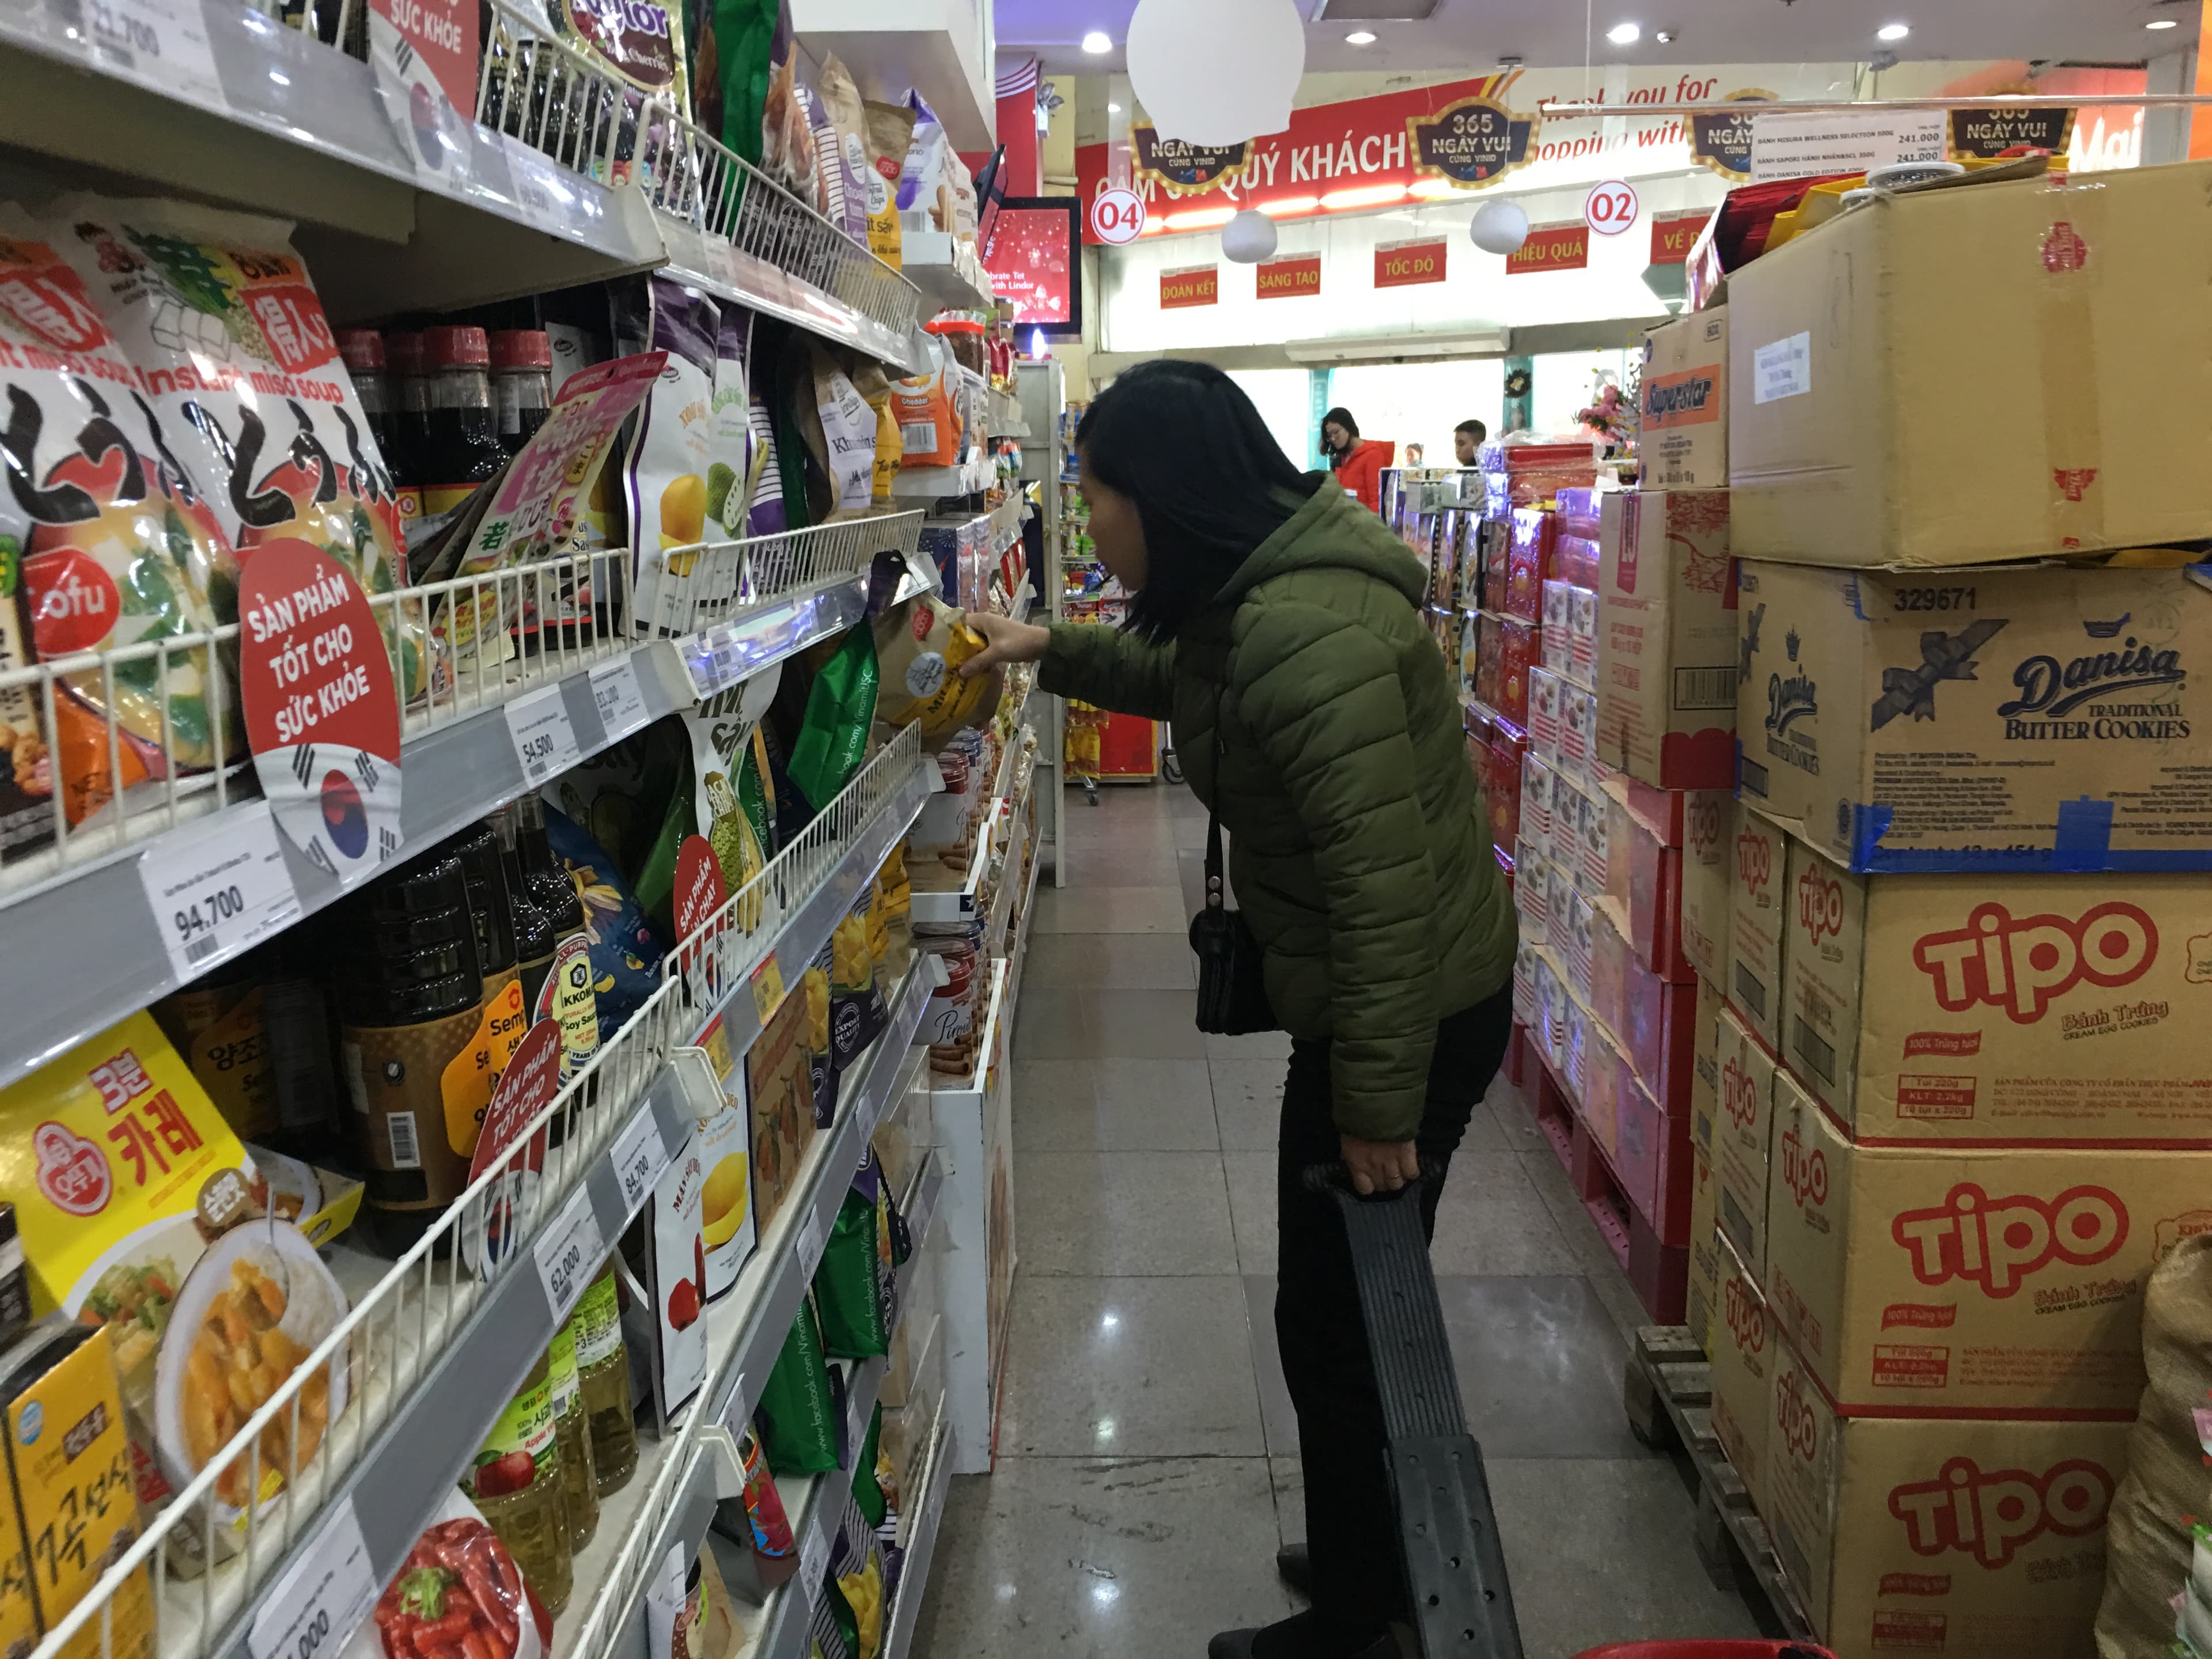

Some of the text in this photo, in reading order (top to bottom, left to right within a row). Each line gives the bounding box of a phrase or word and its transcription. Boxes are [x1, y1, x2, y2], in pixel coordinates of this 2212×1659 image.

[424, 10, 463, 55] KHỎE
[1675, 74, 1718, 103] for
[1452, 113, 1494, 134] 365
[1898, 133, 1940, 144] 241.000
[1967, 116, 2047, 139] NGÀY VUI
[1291, 130, 1405, 182] KHÁCH
[1431, 136, 1512, 154] NGÀY VUI
[1897, 151, 1938, 162] 241.000
[1098, 201, 1139, 231] 04
[1591, 194, 1631, 223] 02
[1384, 252, 1434, 277] TỐC ĐỘ
[1551, 236, 1584, 263] QUẢ
[1009, 281, 1035, 290] Lindor
[1013, 271, 1025, 280] Tet
[1196, 278, 1215, 296] KẾT
[1259, 271, 1292, 289] SÁNG
[296, 378, 344, 404] soup
[901, 396, 929, 406] Cheddar
[27, 575, 105, 620] ofu
[248, 564, 350, 643] SẢN PHẨM
[1893, 587, 1977, 611] 329671
[270, 624, 353, 689] TỐT CHO
[1998, 637, 2187, 718] Danisa
[275, 661, 371, 743] SỨC KHỎE
[2088, 703, 2183, 717] TRADITIONAL
[2004, 718, 2190, 740] BUTTER COOKIES
[521, 733, 555, 764] 54.500
[1737, 824, 1770, 896] Tipo
[175, 885, 244, 941] 94.700
[1798, 862, 1843, 946] Tipo
[1913, 901, 2160, 1025] Tipo
[835, 1013, 861, 1034] EXPORT
[2062, 1012, 2109, 1032] Bánh
[493, 1074, 521, 1118] SẢN
[522, 1032, 558, 1086] PHẨM
[520, 1074, 545, 1116] CHO
[1723, 1056, 1756, 1130] Tipo
[107, 1088, 204, 1187] 카레
[625, 1154, 650, 1195] 84.700
[1892, 1182, 2130, 1299] Tipo
[551, 1244, 581, 1293] 62.000
[1777, 1370, 1816, 1461] Tipo
[524, 1430, 547, 1449] Apple
[1888, 1456, 2116, 1570] Tipo
